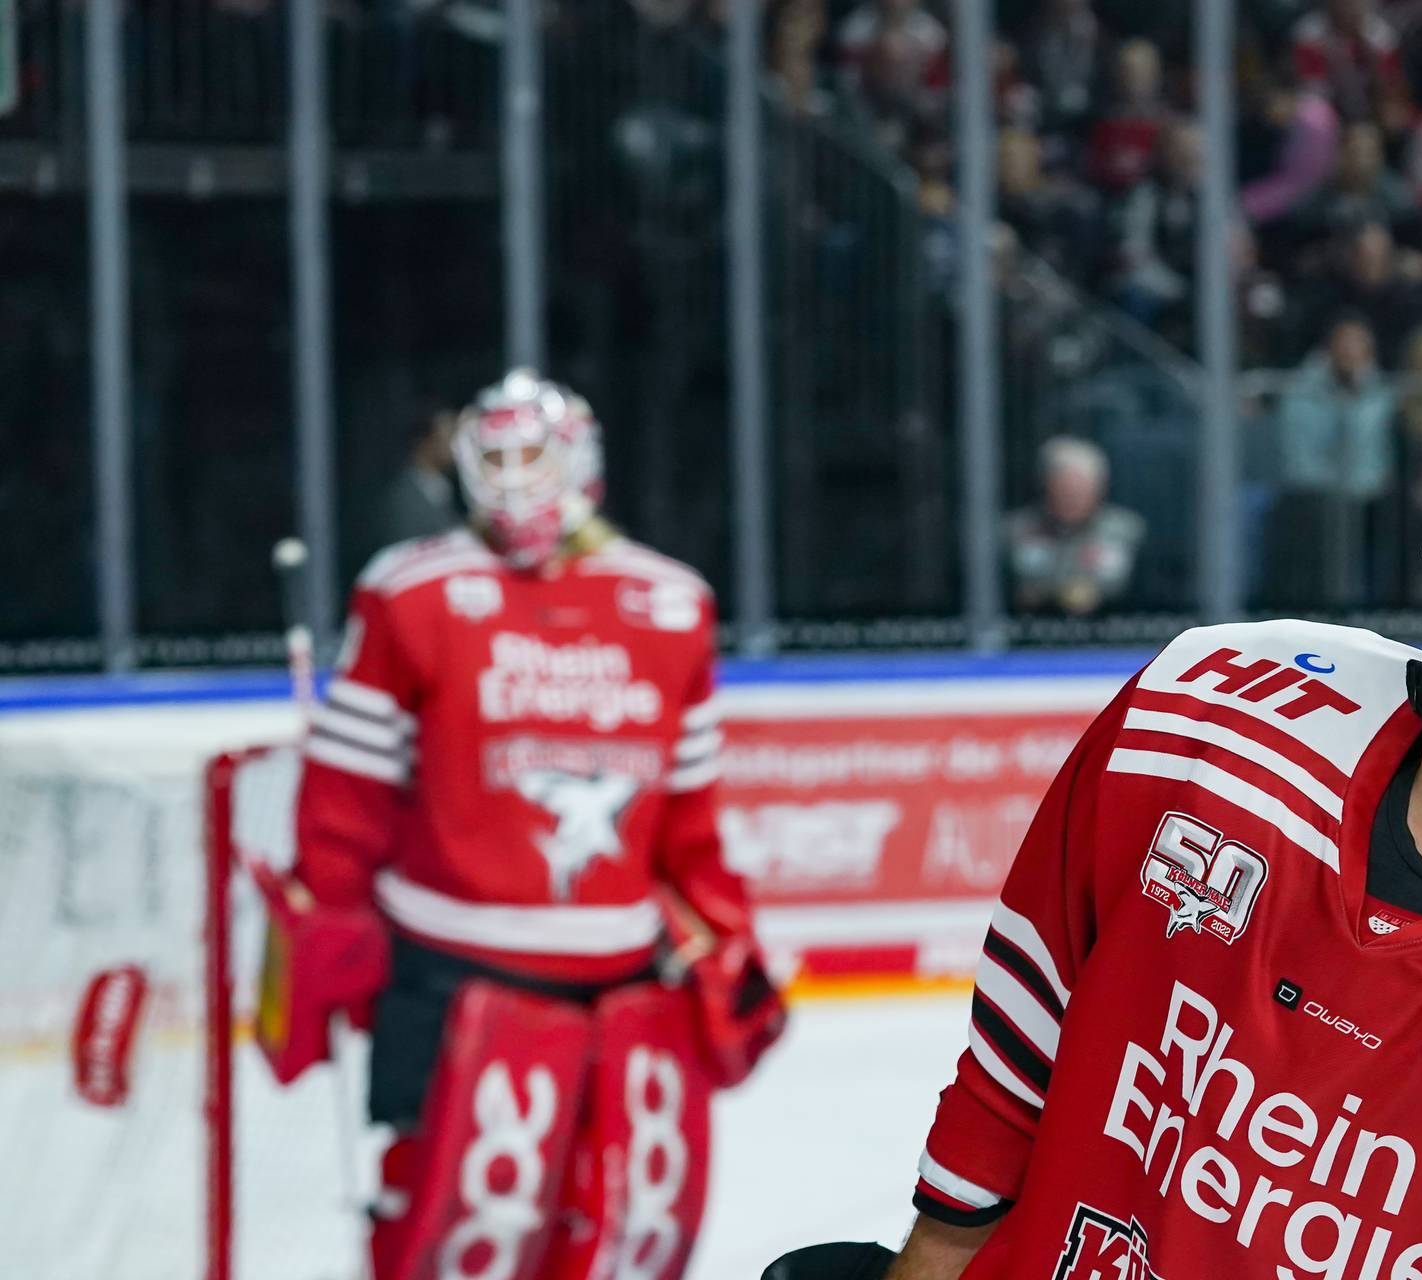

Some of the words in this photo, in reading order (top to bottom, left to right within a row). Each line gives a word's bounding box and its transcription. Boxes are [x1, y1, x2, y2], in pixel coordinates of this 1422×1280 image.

[1175, 647, 1362, 721] HIT
[1141, 811, 1269, 938] 50
[1149, 883, 1171, 902] 1972
[1210, 919, 1231, 938] 2022
[1160, 979, 1418, 1217] Rhein
